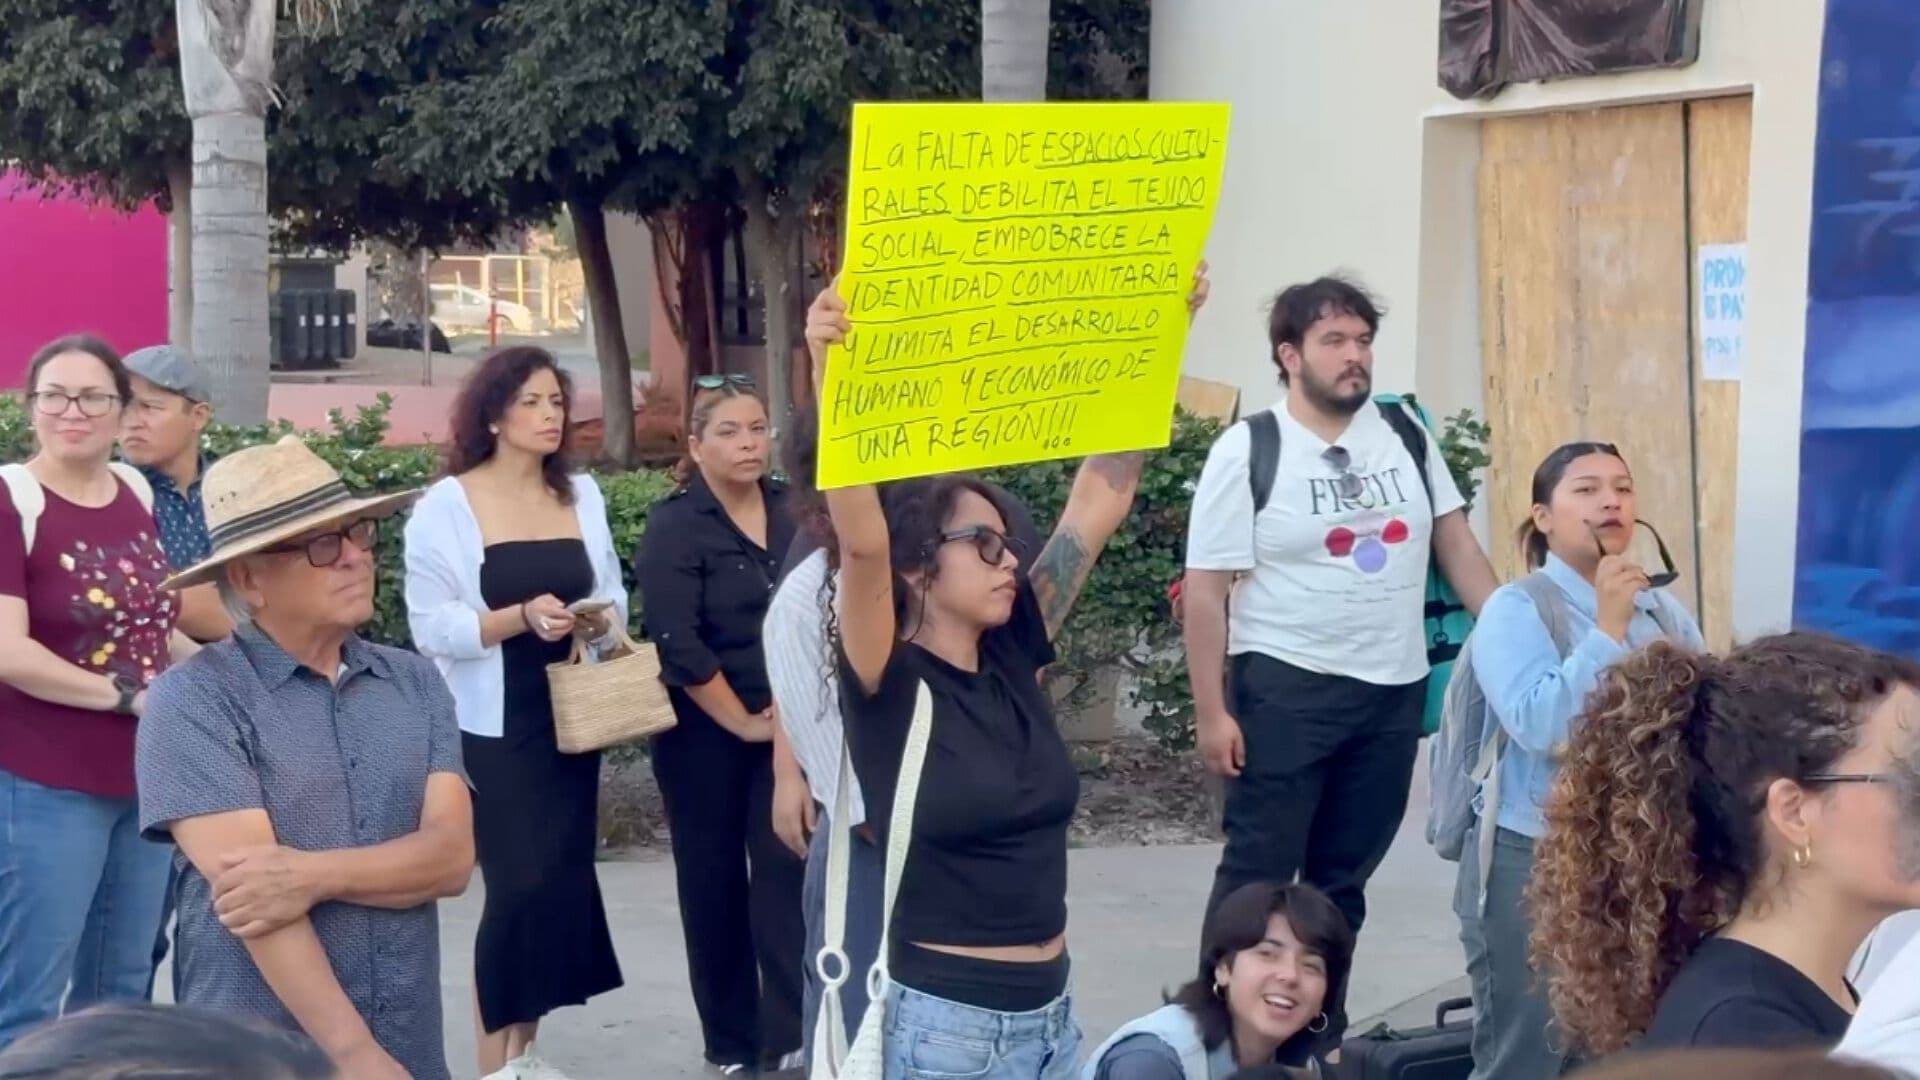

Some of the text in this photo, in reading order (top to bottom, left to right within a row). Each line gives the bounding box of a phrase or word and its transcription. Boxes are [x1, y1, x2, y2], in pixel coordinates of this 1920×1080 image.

[862, 123, 1220, 171] La FALTA DE ESPACIOS CULTU-
[863, 175, 1206, 221] RALES DEBILITA EL TEJIDO
[861, 223, 1171, 268] SOCIAL, EMPOBRECE LA
[850, 262, 1179, 316] IDENTIDAD COMUNITARIA
[1720, 292, 1745, 320] PA
[842, 309, 1160, 371] Y LIMITA EL DESARROLLO
[832, 348, 1157, 426] HUMANO Y ECONÓMICO DE
[857, 401, 1079, 464] UNA REGIÓN!!!
